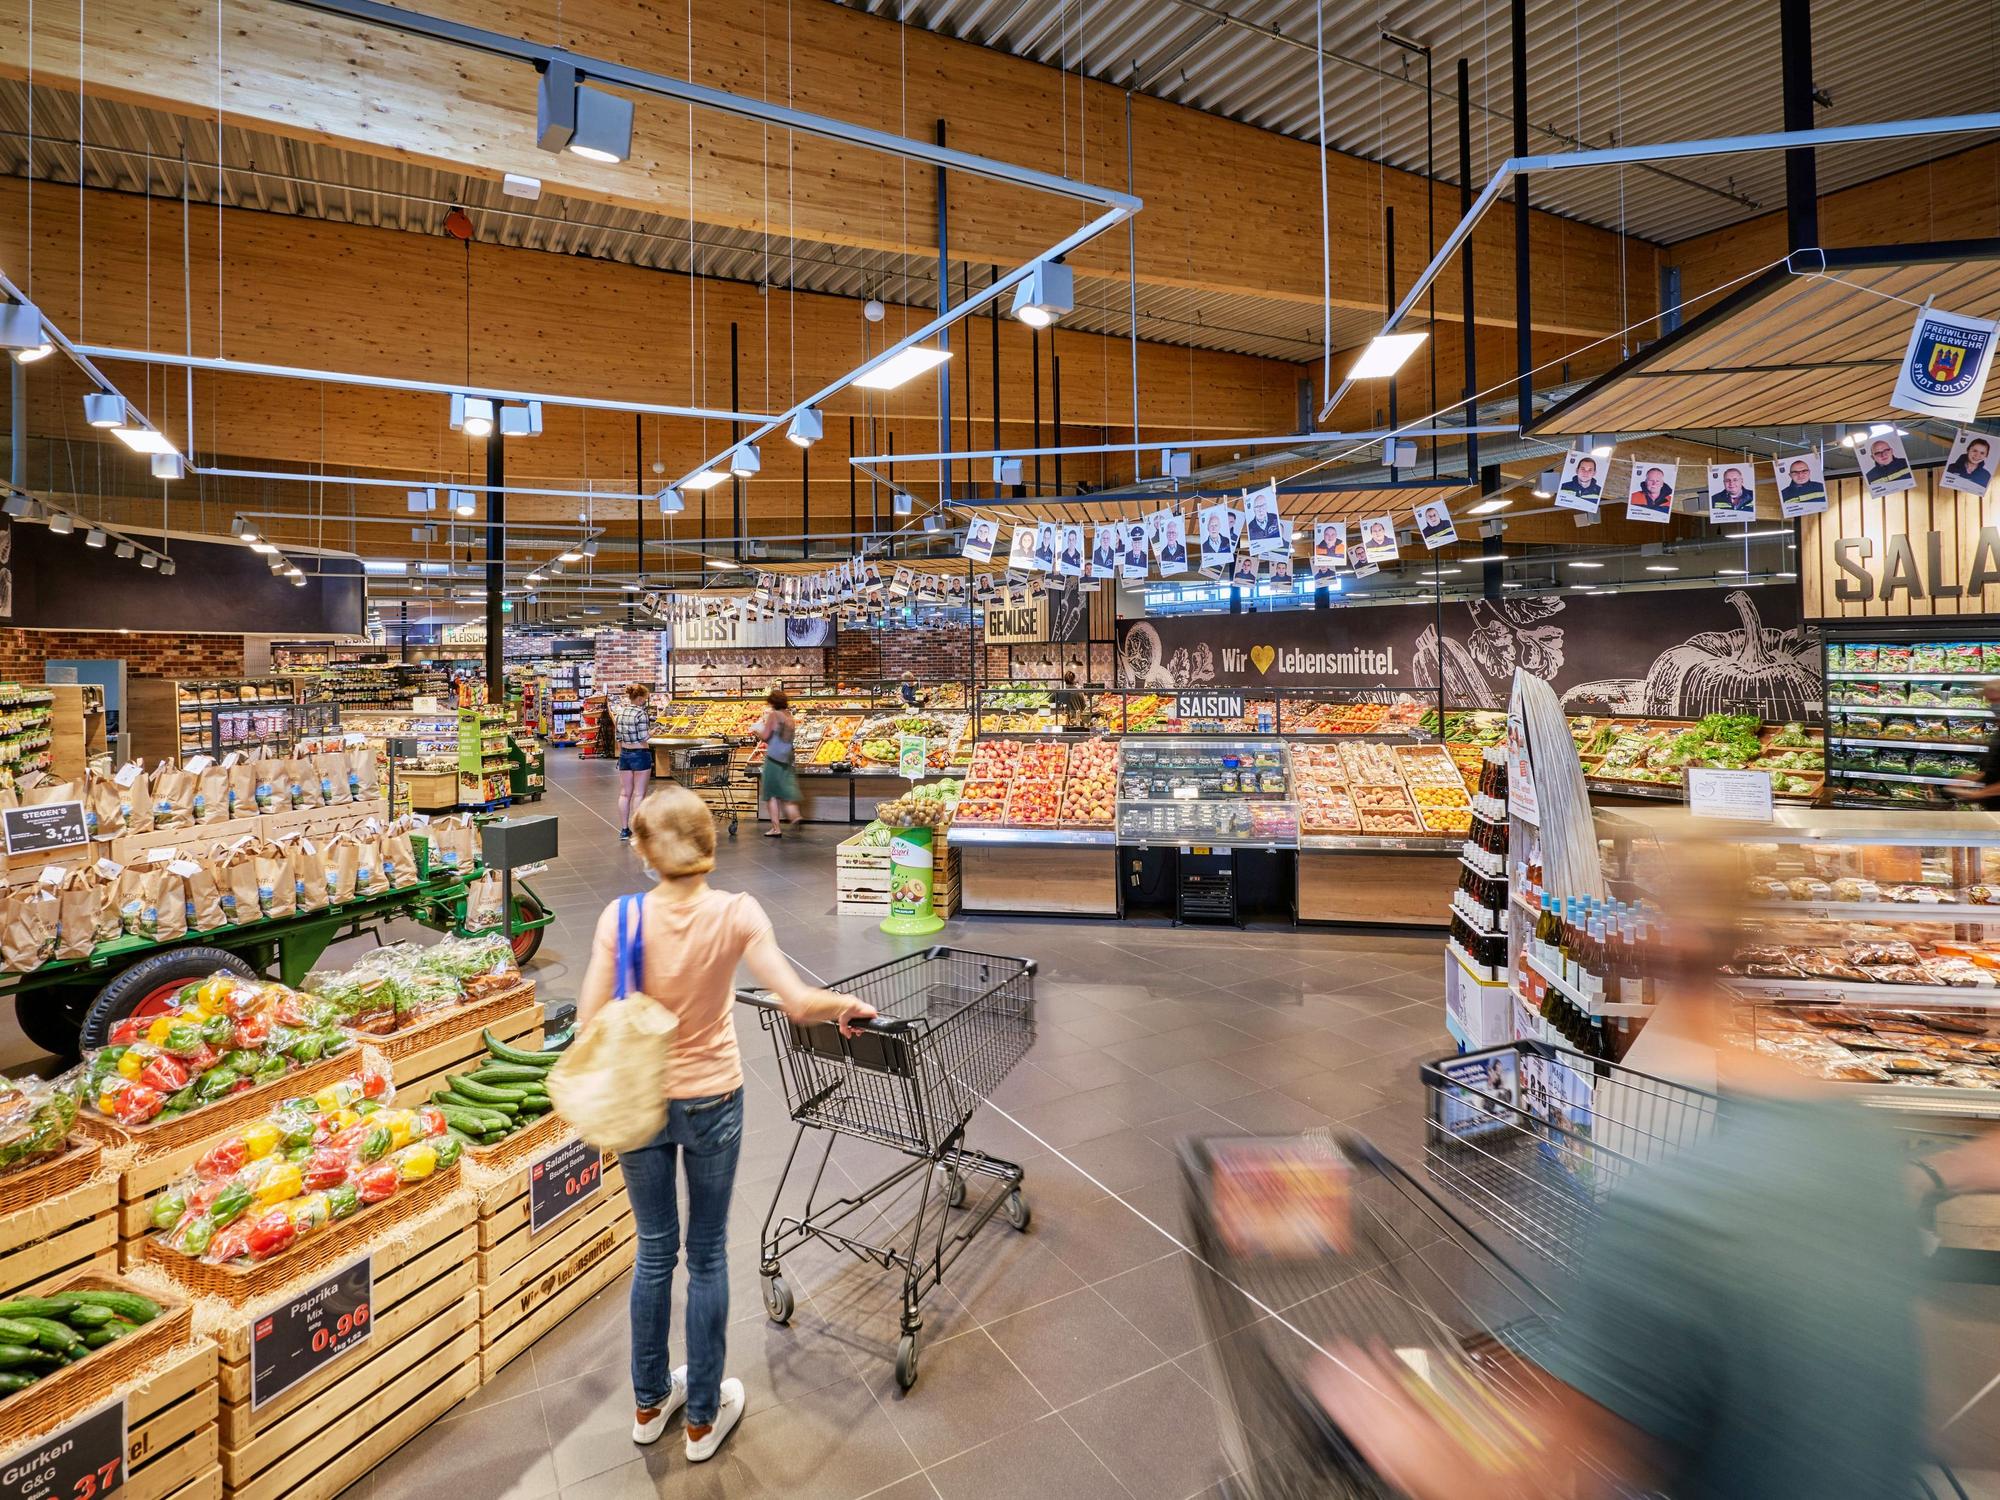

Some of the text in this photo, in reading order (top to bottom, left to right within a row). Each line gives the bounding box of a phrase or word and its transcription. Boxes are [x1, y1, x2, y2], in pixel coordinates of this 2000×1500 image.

[1924, 332, 1983, 350] FEUERWEHR
[1926, 324, 1985, 342] FREIWILLIGE
[1914, 363, 1972, 392] STADT SOLTAU
[1222, 646, 1399, 675] Wir Lebensmittel.
[1180, 697, 1241, 717] SAISON
[46, 824, 81, 840] 3,71
[566, 1160, 600, 1196] 0,67
[291, 1284, 339, 1318] Paprika
[520, 1290, 539, 1312] Wir
[306, 1308, 323, 1323] Mix
[311, 1303, 370, 1353] 0,96
[3, 1439, 73, 1485] Gurken
[21, 1467, 56, 1494] G&G
